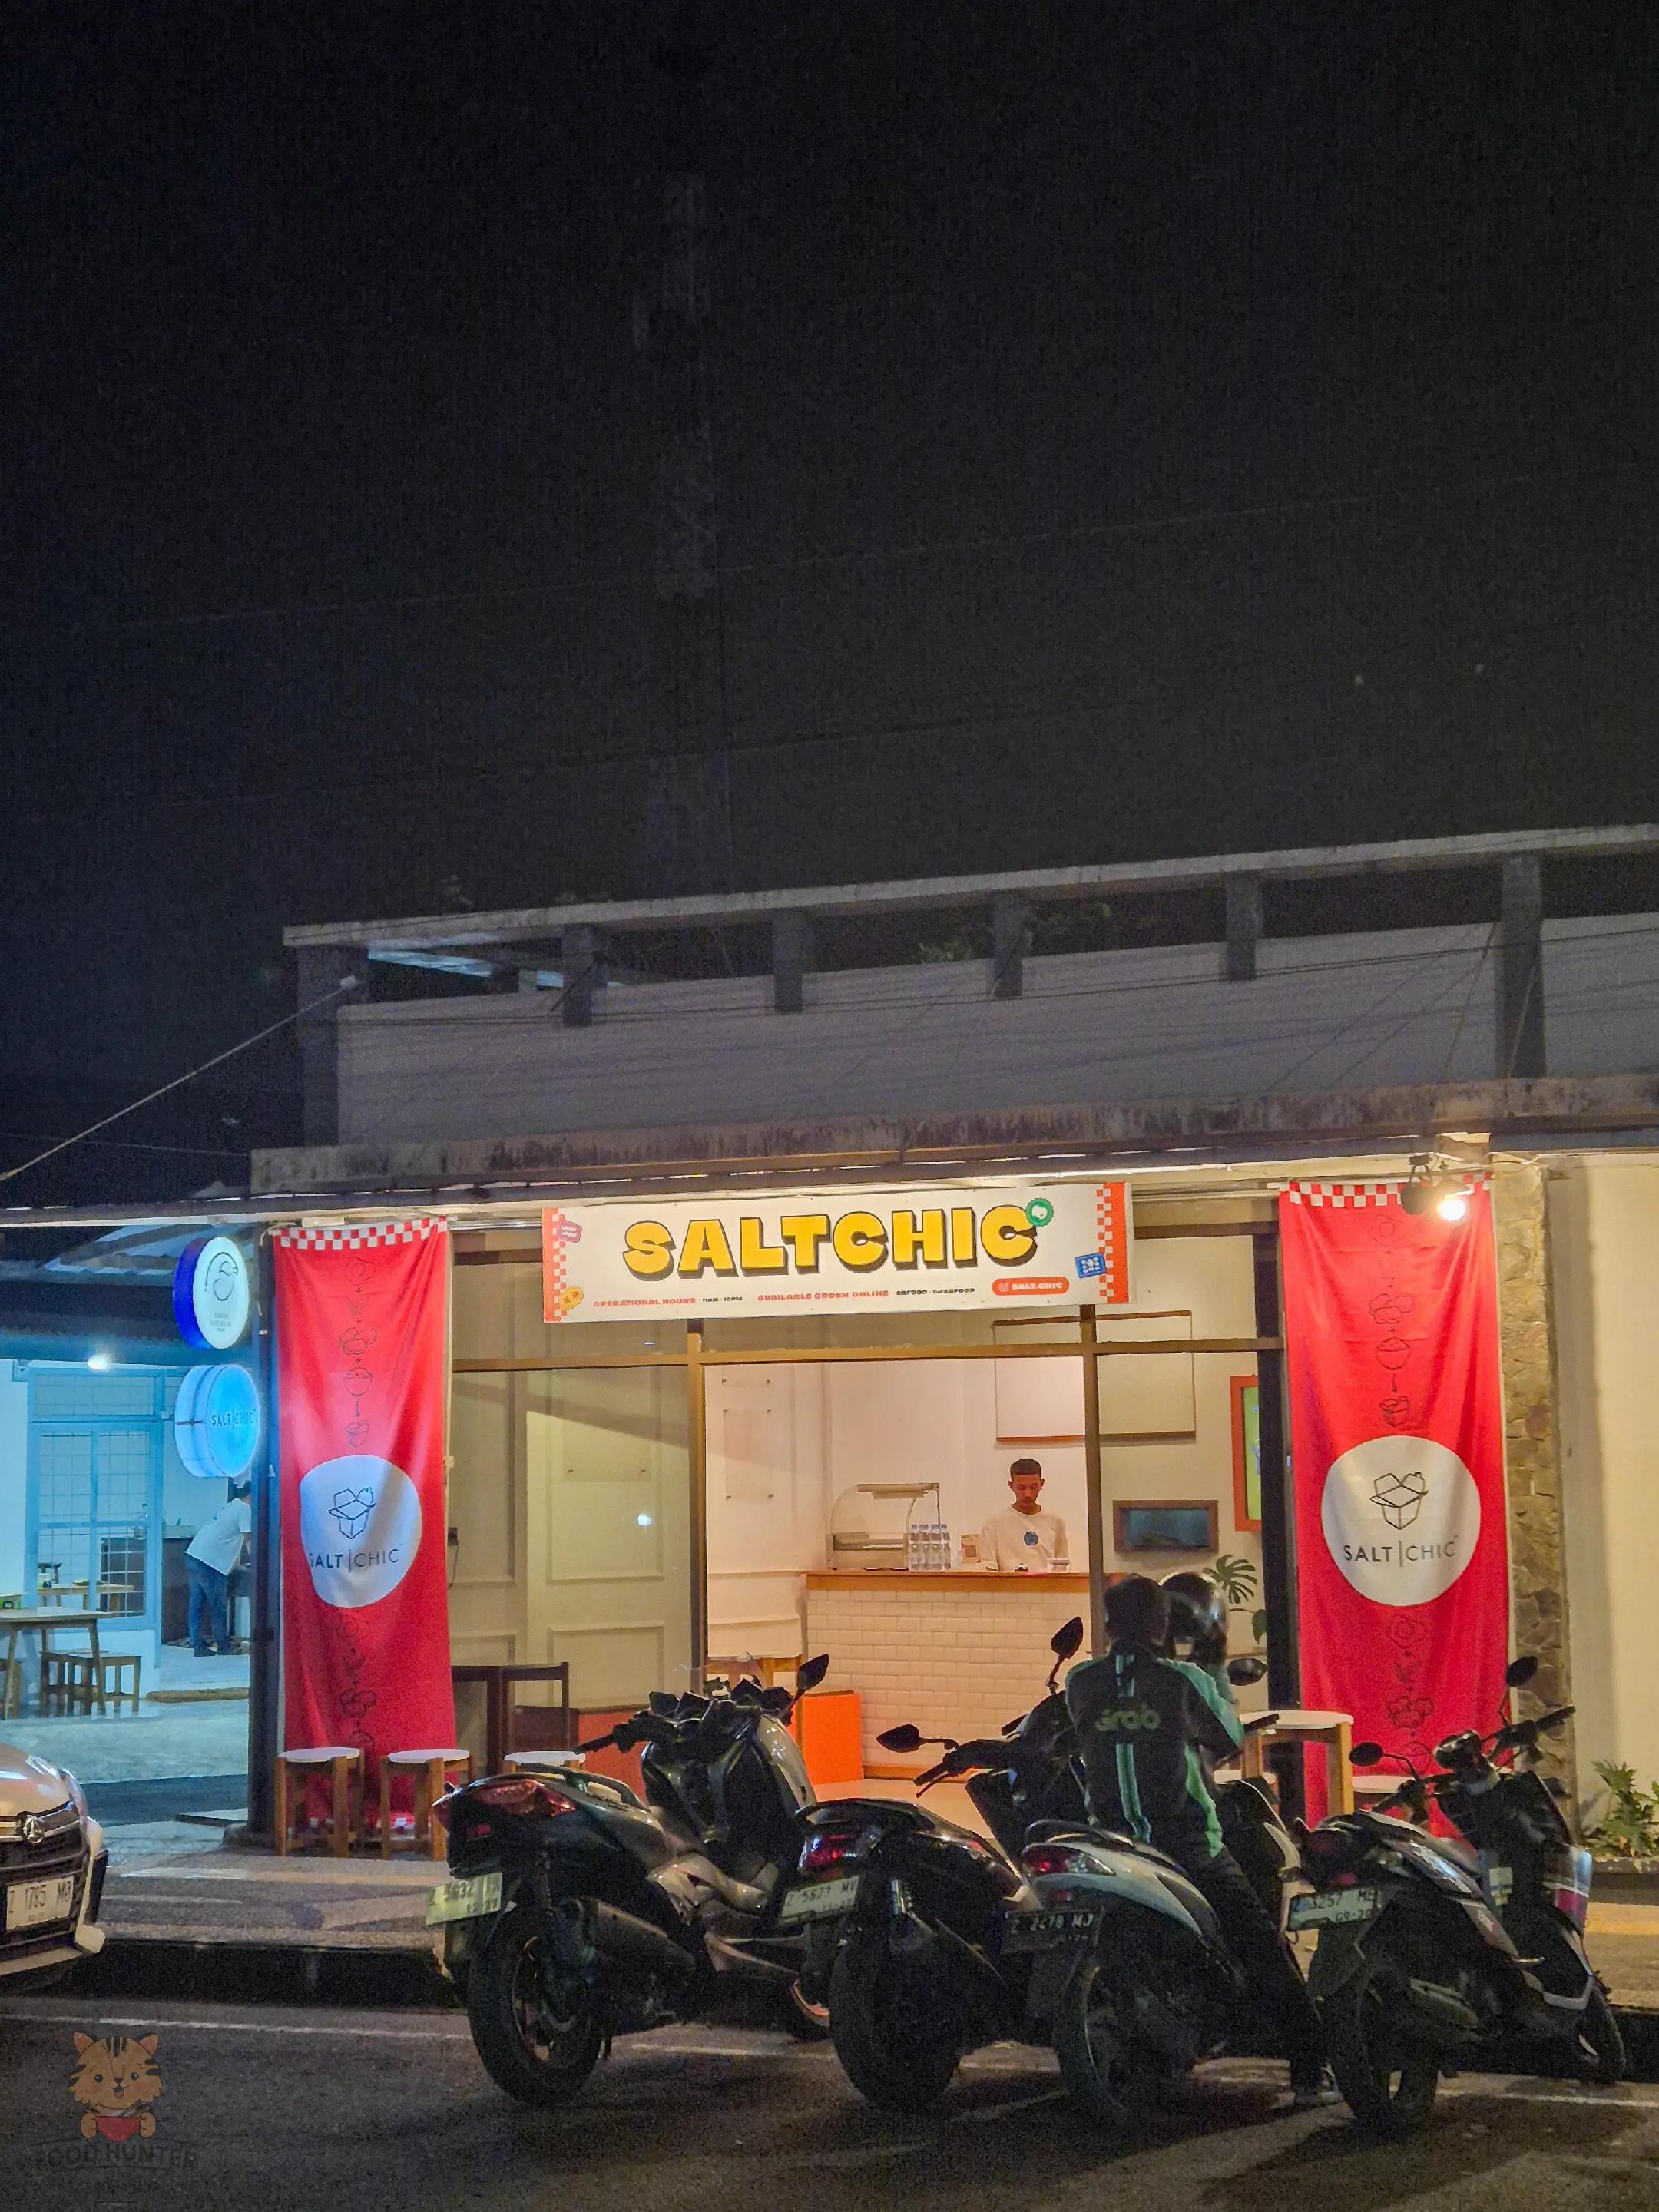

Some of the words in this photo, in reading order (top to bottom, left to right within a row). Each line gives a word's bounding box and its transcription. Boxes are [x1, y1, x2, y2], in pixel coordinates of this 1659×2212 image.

[623, 1204, 1038, 1281] SALTCHIC
[757, 1293, 812, 1302] AVAILABLE
[852, 1290, 889, 1298] ONLINE
[593, 1298, 660, 1307] OPERATIONAL
